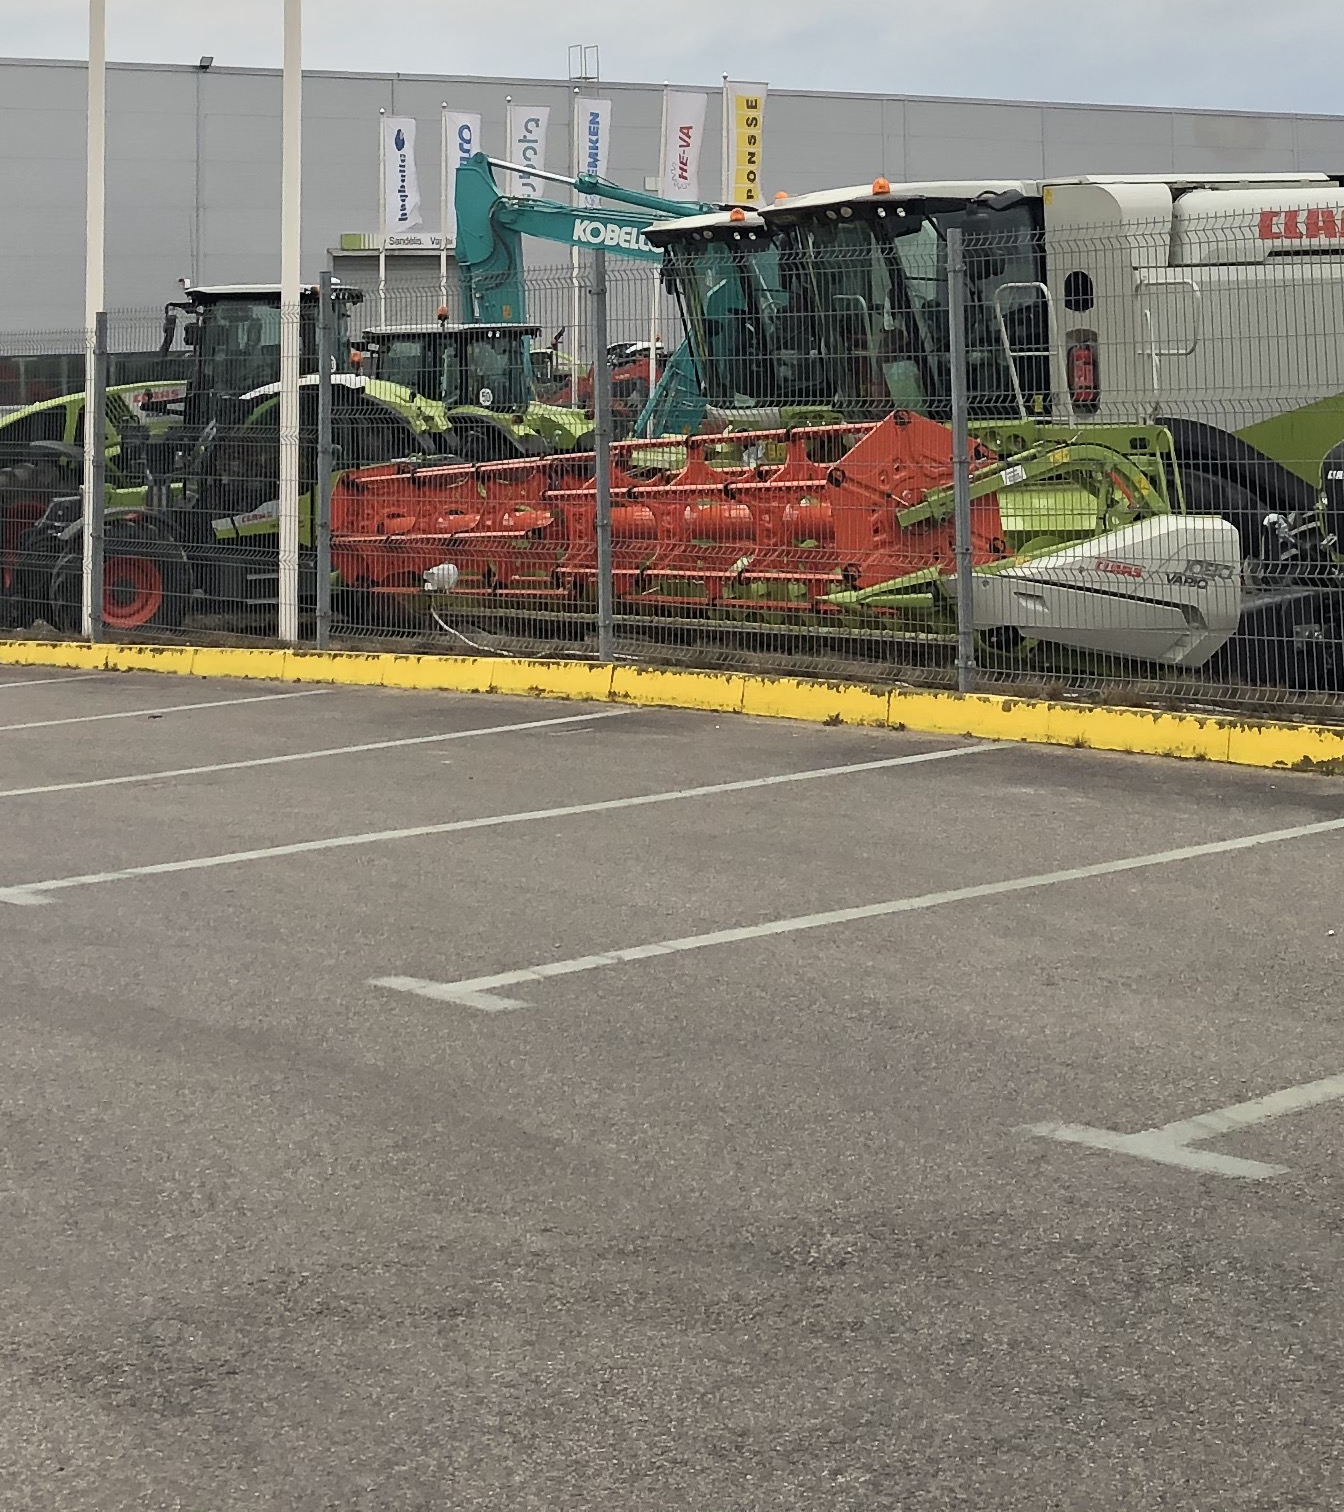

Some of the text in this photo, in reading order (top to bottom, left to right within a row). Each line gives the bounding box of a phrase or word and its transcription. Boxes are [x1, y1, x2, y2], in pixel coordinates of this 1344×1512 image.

[677, 124, 694, 181] HE-VA
[745, 98, 758, 200] PONSSE
[1095, 558, 1143, 578] CLAAS
[1166, 573, 1208, 589] VARIO
